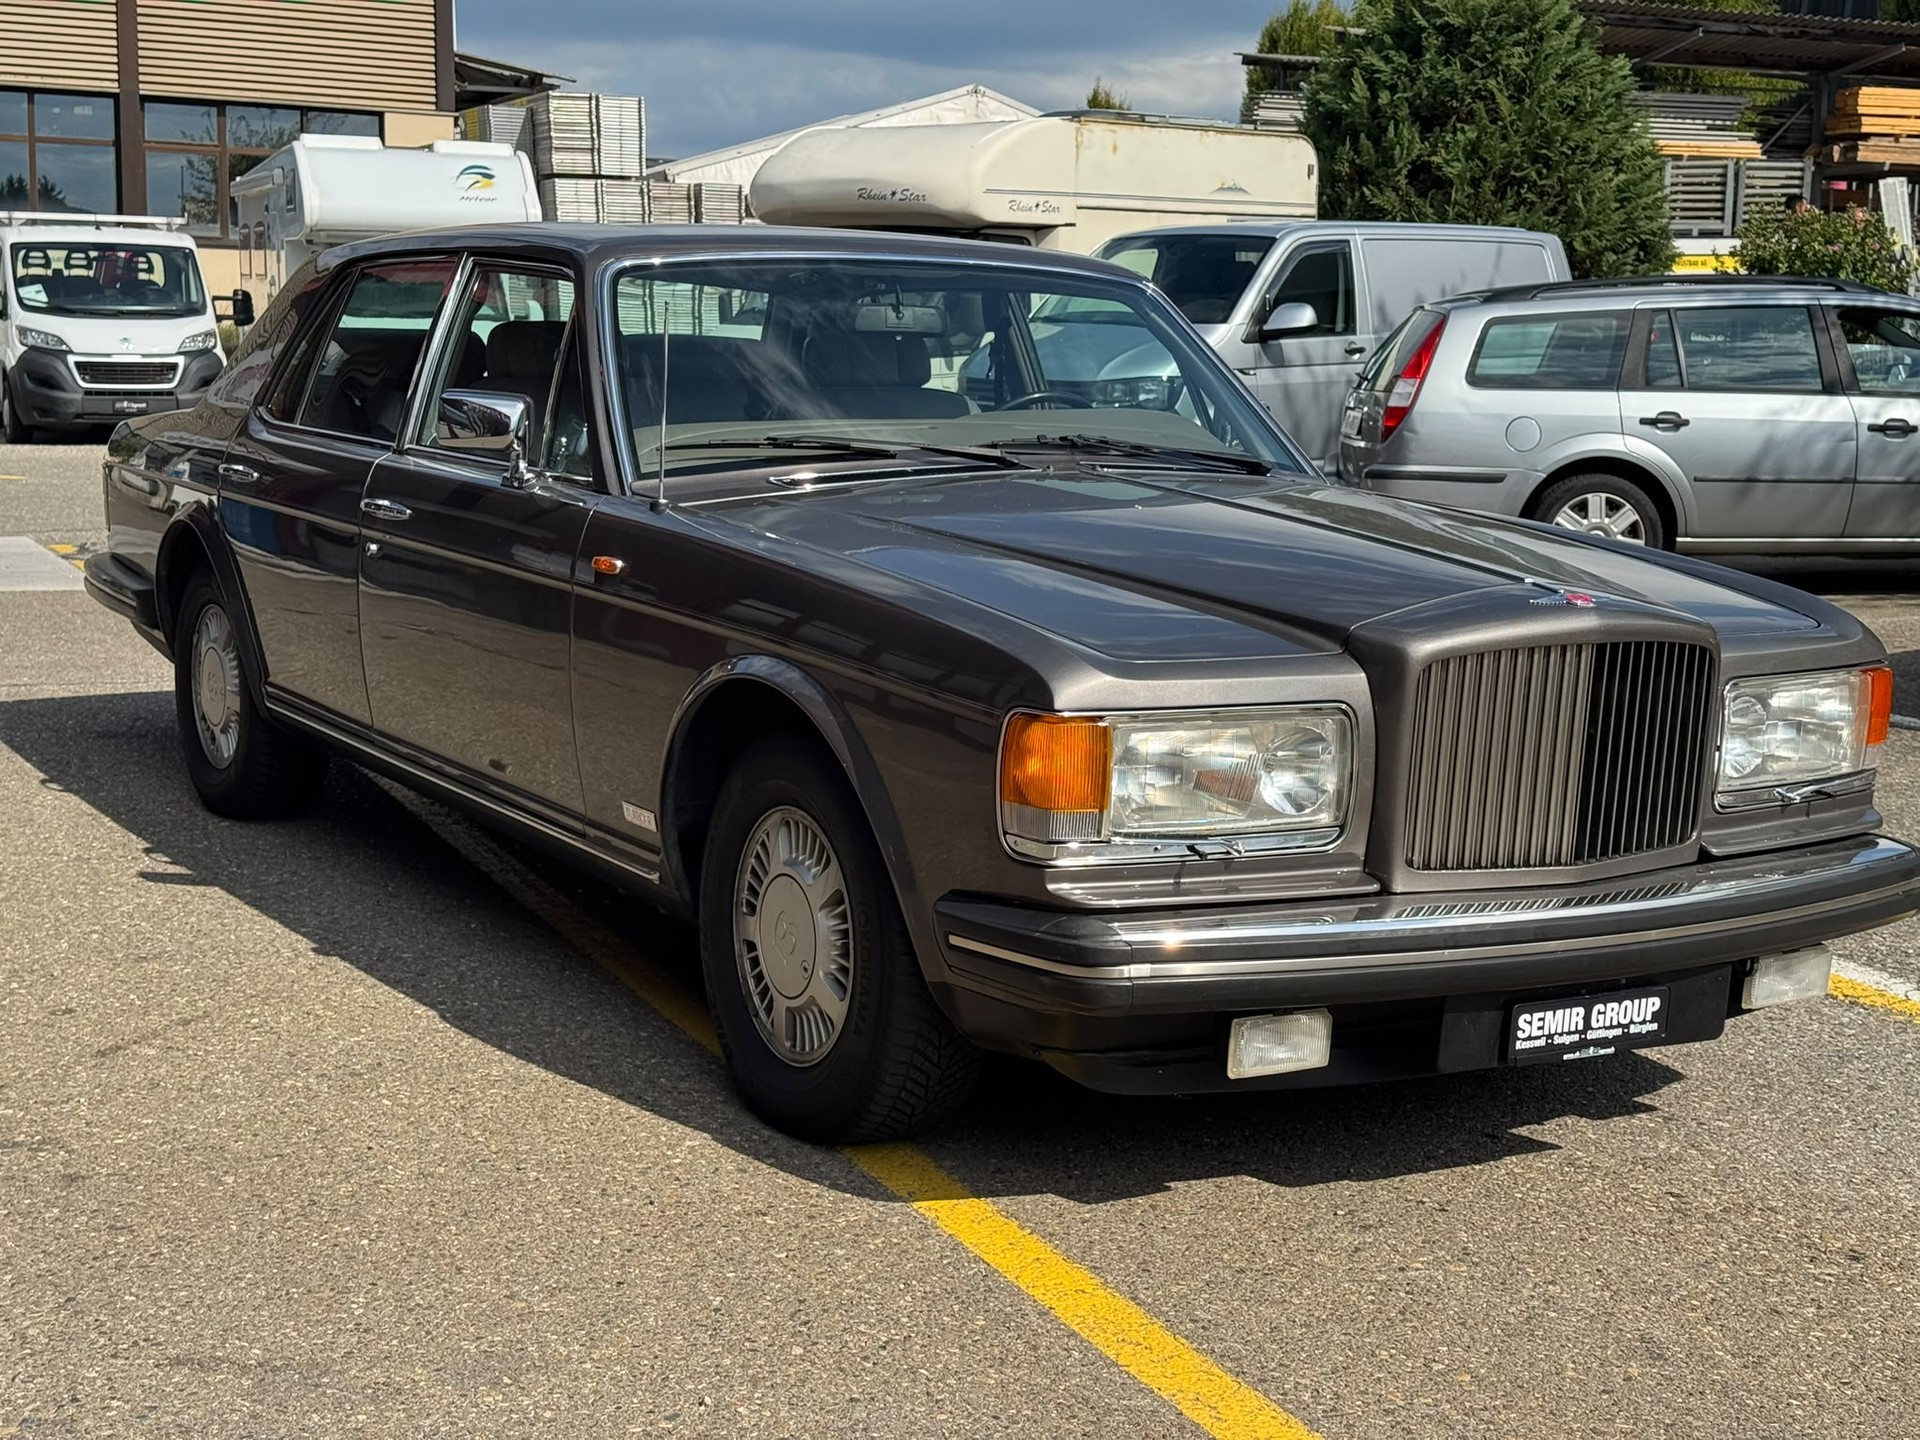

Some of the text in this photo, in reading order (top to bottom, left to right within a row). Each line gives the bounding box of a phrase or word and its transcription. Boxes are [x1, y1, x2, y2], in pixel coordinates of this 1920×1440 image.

[857, 187, 927, 202] Rhein Star
[1041, 200, 1060, 213] Star
[853, 893, 872, 1036] YOKOHAMA
[1517, 996, 1661, 1039] SEMIR GROUP
[1515, 1037, 1546, 1050] Kesswil
[1553, 1032, 1580, 1045] Sulgen
